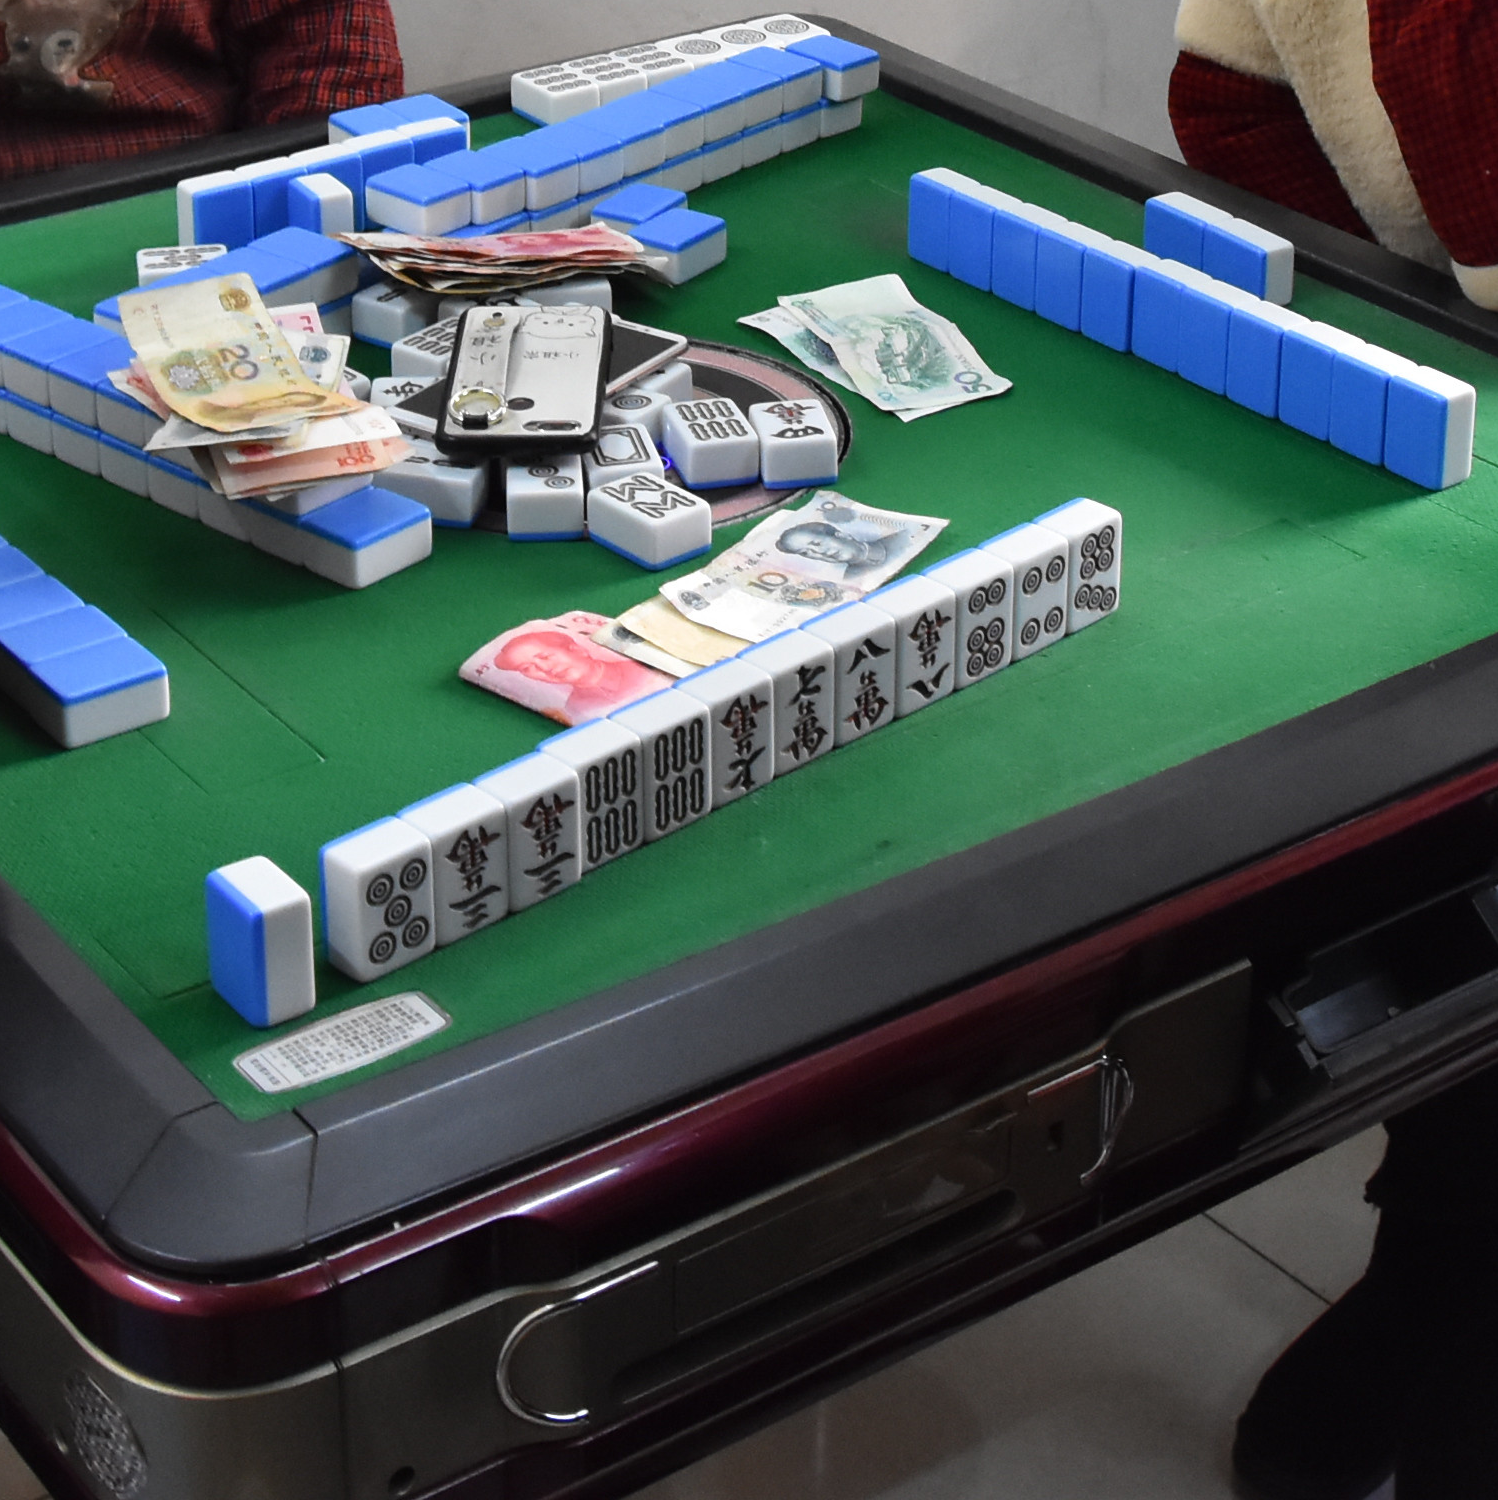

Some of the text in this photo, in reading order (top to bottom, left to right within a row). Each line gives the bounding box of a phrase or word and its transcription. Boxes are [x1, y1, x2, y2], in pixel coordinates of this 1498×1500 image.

[217, 343, 260, 381] 20
[953, 370, 993, 394] 50
[747, 571, 789, 594] 10
